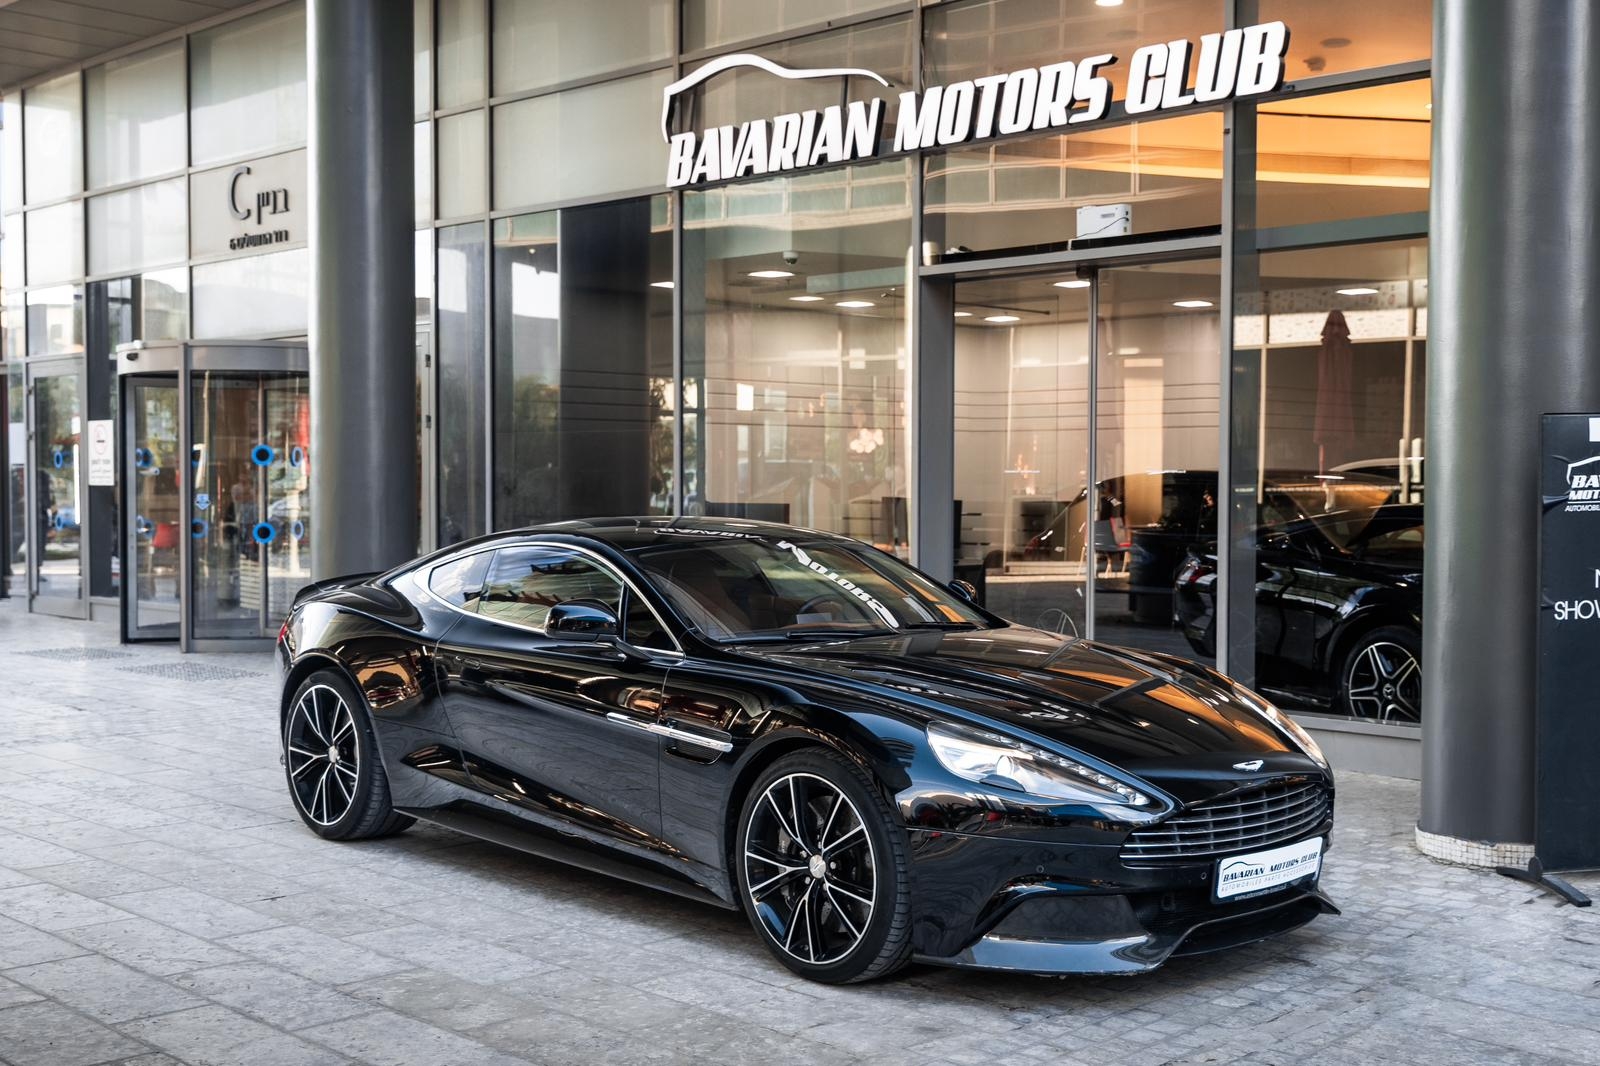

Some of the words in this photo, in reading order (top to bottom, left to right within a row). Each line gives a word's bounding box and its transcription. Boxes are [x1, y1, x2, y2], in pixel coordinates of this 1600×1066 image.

[666, 97, 885, 190] BAVARIAN
[893, 53, 1117, 152] MOTORS
[1125, 20, 1290, 115] CLUB
[1571, 475, 1600, 488] BA
[1223, 866, 1265, 882] BAVARIAN
[1270, 857, 1299, 873] MOTORS
[1300, 851, 1318, 863] CLUB
